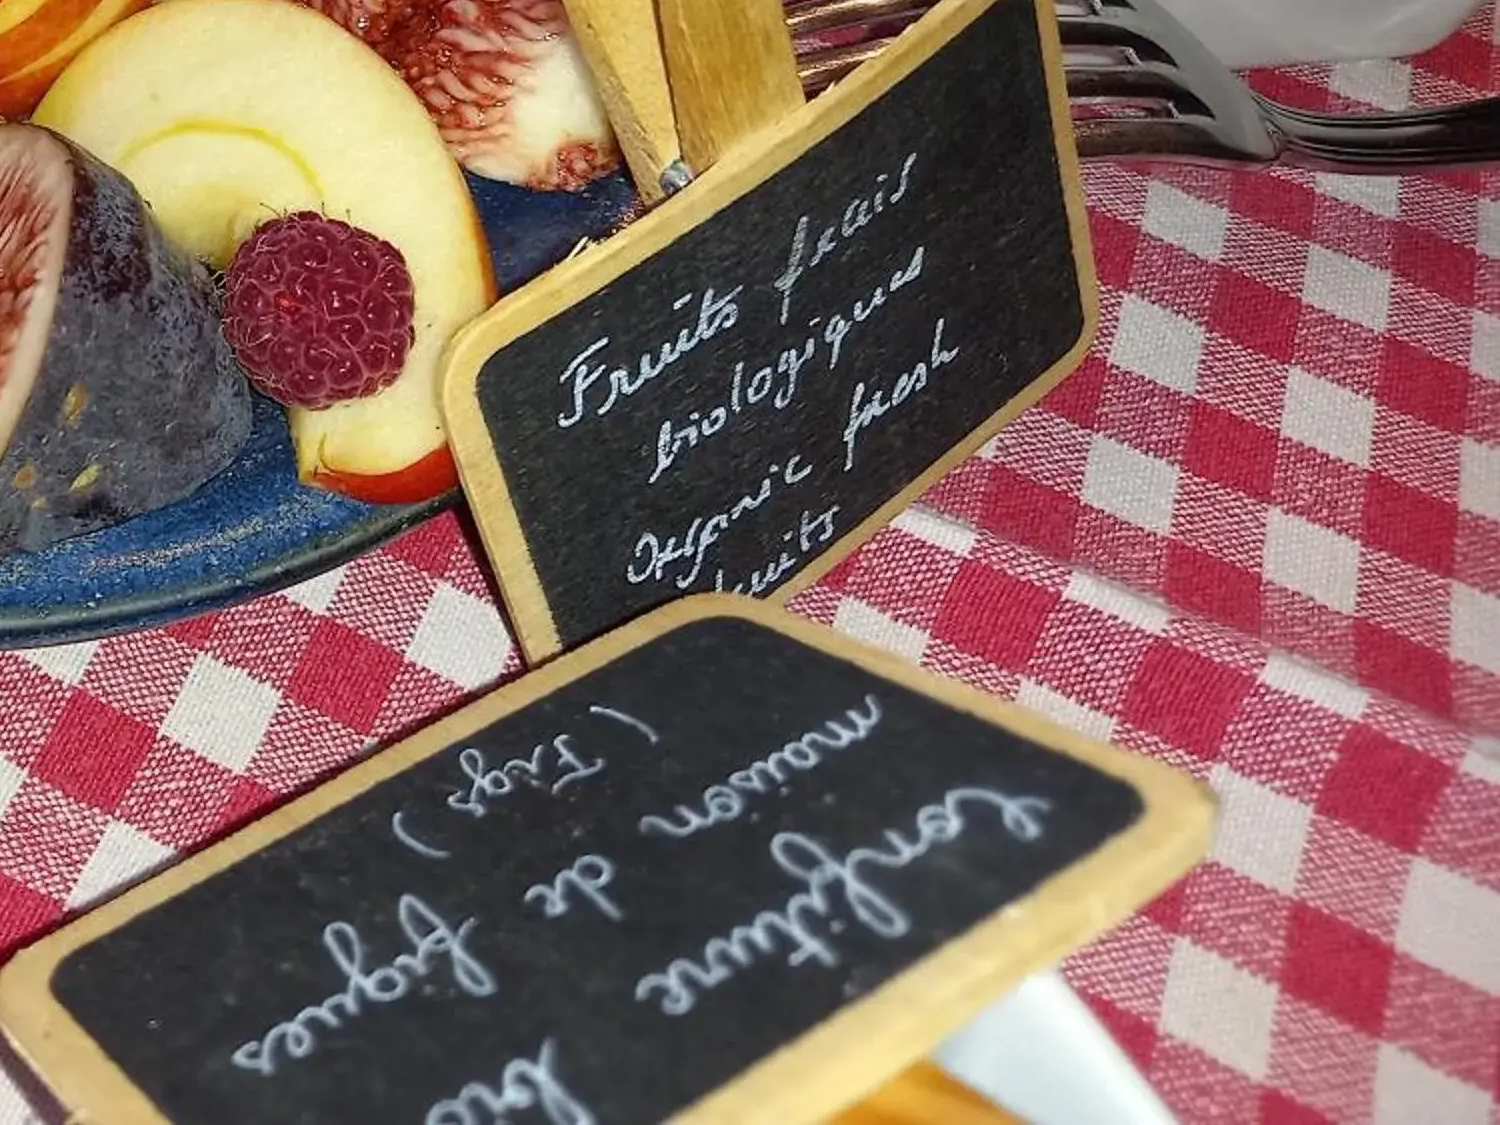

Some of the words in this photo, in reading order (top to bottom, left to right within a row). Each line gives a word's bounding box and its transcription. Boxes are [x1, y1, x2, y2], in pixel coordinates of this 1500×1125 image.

[559, 284, 743, 427] Fruits
[774, 152, 916, 323] frais
[649, 247, 922, 484] biologiques
[628, 455, 812, 588] Organic
[843, 318, 958, 471] fresh
[639, 694, 882, 835] maison
[231, 894, 496, 1074] figues
[524, 854, 624, 920] de
[635, 789, 1053, 1015] Confiture
